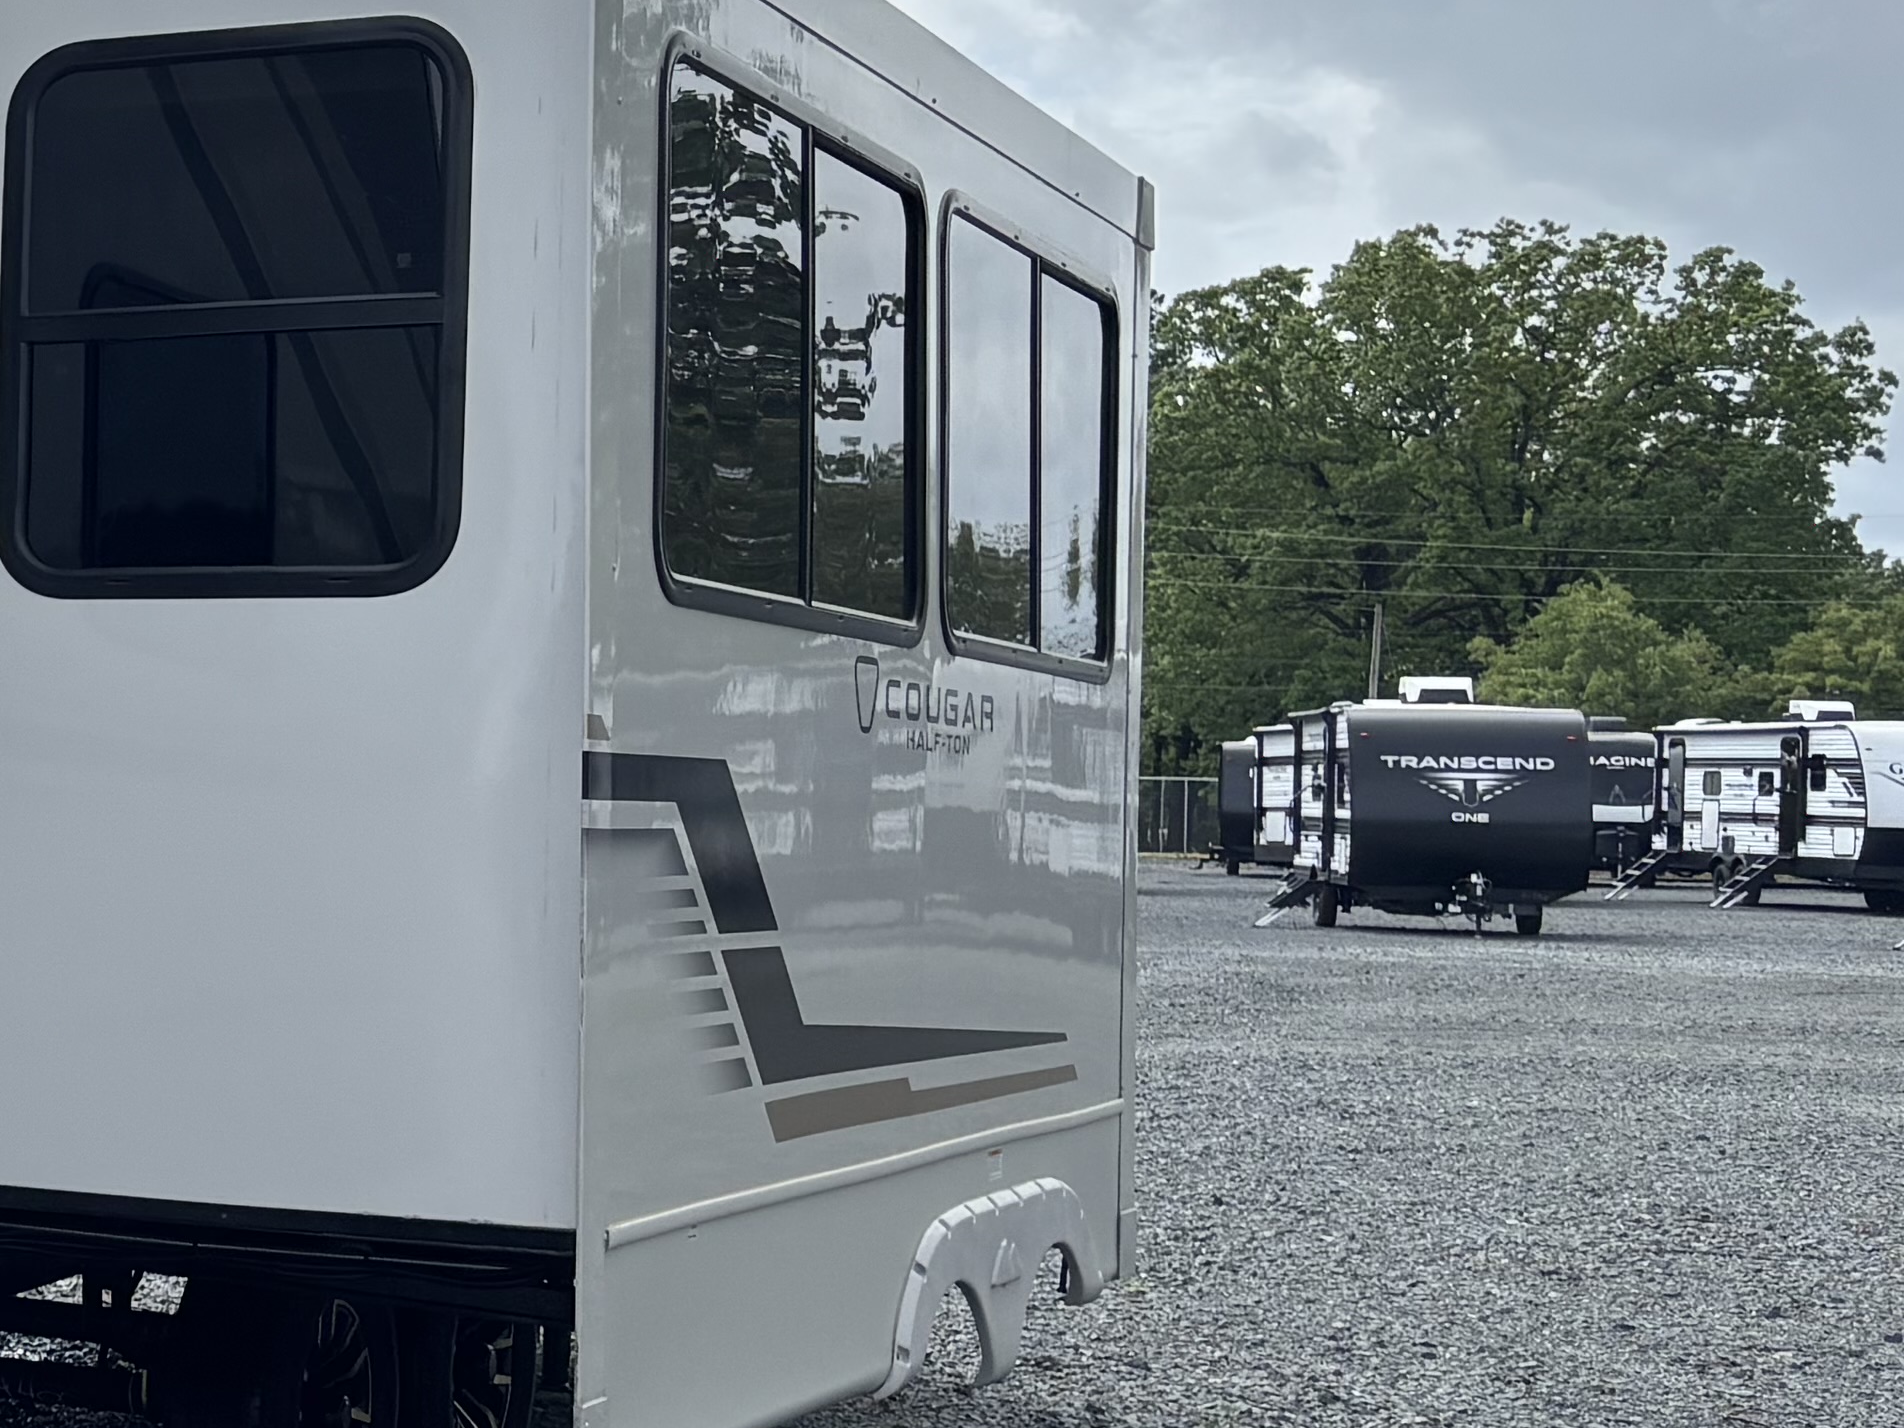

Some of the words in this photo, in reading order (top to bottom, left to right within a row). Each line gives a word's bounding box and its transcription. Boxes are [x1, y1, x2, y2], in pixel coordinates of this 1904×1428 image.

[885, 679, 994, 732] COUGAR
[906, 730, 971, 755] HALF-TON
[1379, 755, 1556, 771] TRANSCEND
[1589, 756, 1656, 768] AGINE
[1451, 811, 1490, 823] ONE
